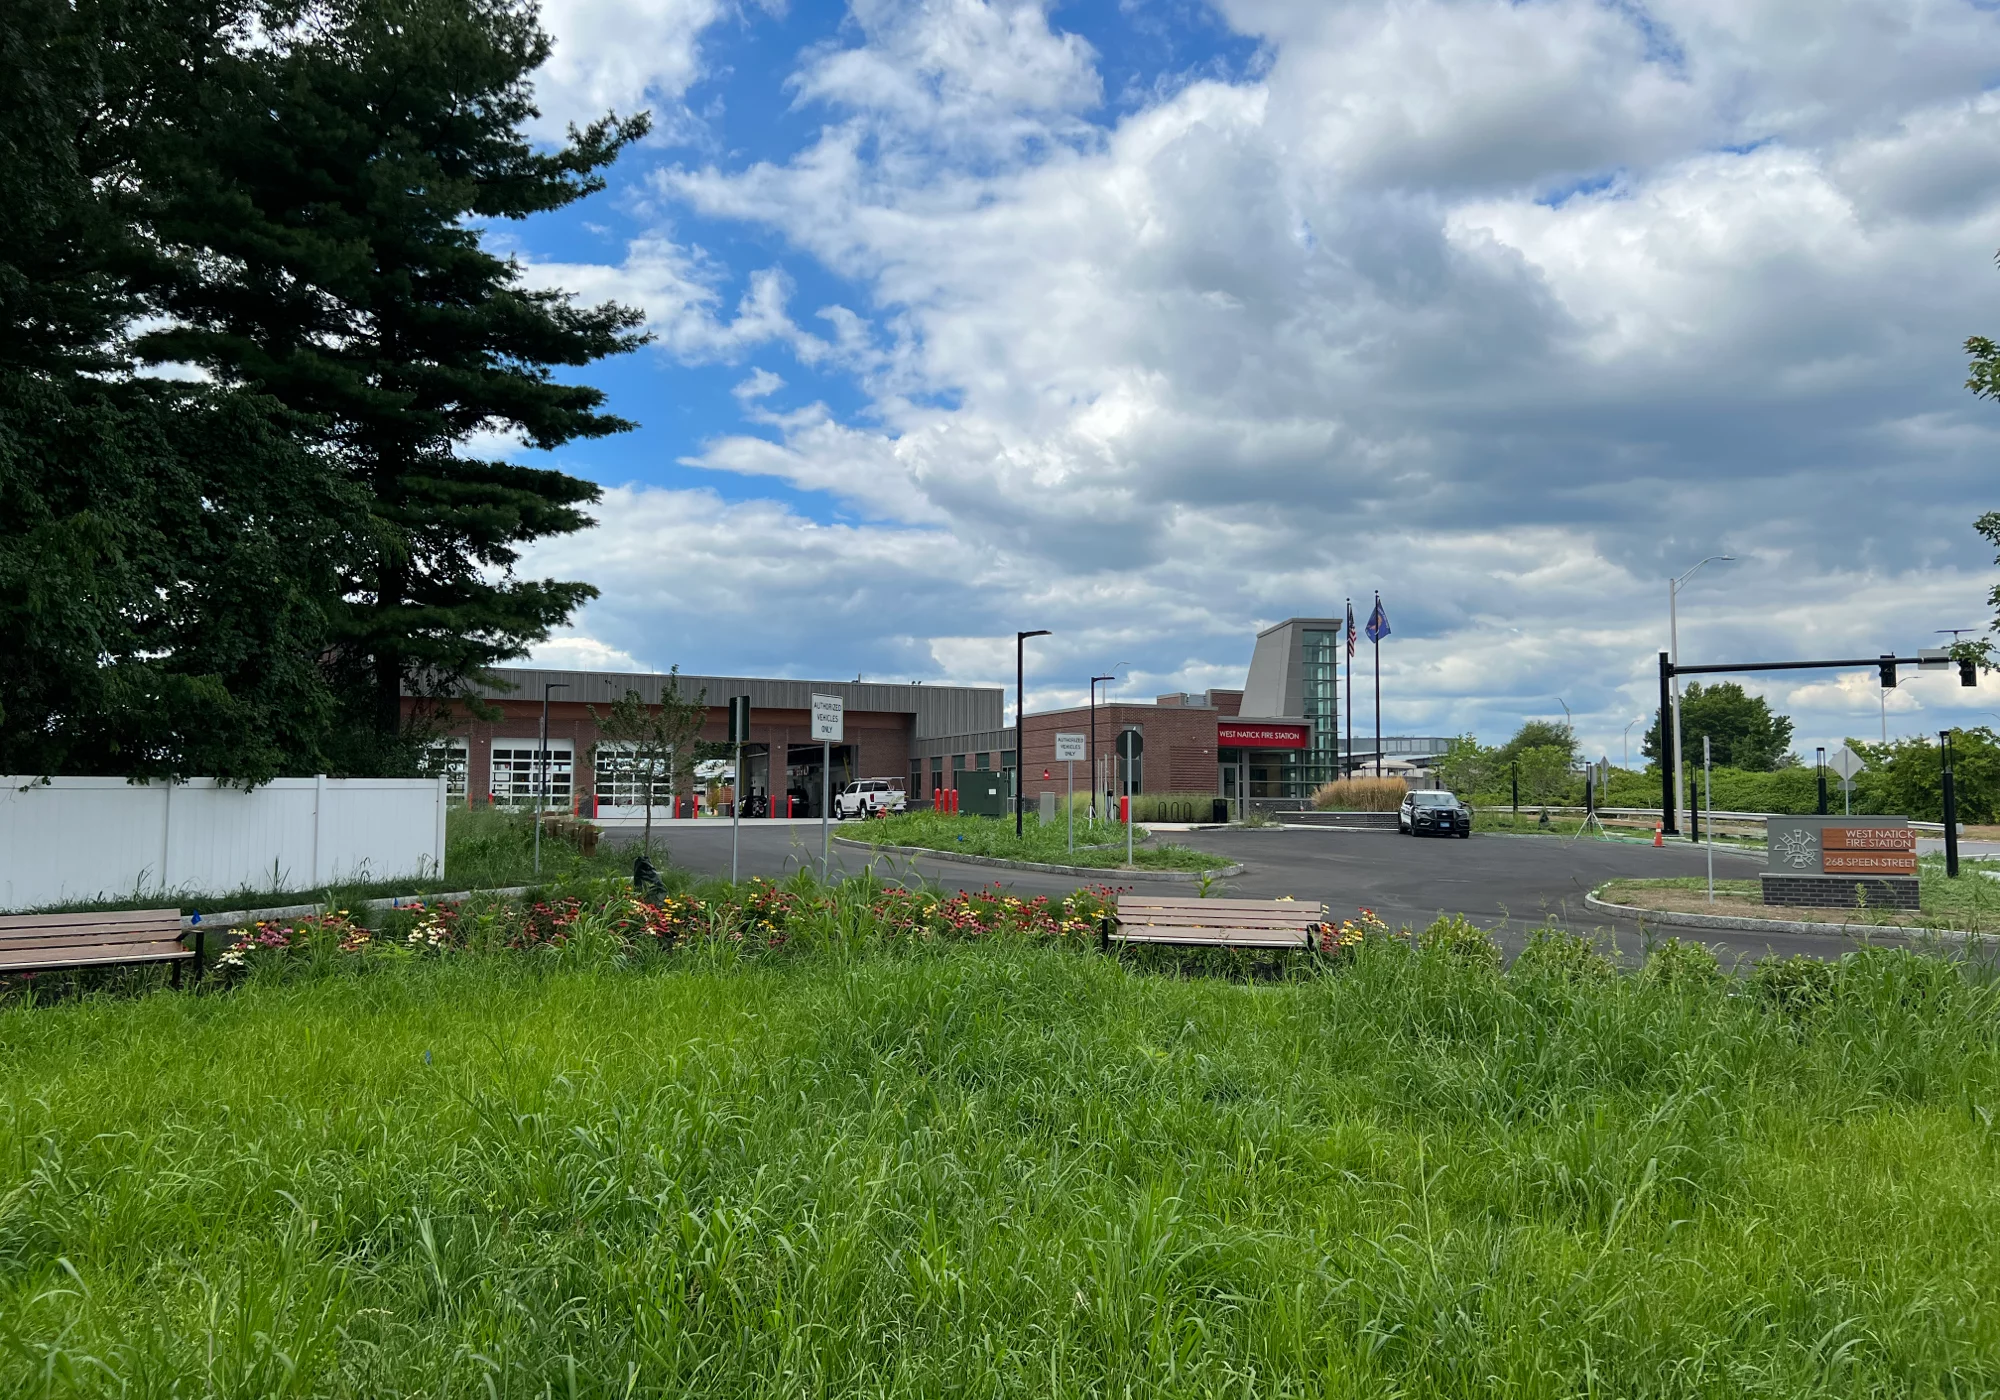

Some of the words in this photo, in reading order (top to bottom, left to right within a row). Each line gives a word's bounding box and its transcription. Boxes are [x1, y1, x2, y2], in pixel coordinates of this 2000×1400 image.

[814, 702, 841, 711] AUTHORIZED
[817, 713, 838, 722] VEHICLES
[821, 725, 832, 733] ONLY
[1219, 730, 1236, 738] WEST
[1237, 731, 1260, 739] NATICK
[1274, 732, 1300, 740] STATION
[1845, 829, 1873, 838] WEST
[1875, 829, 1914, 839] NATICK
[1845, 838, 1866, 847] FIRE
[1869, 839, 1911, 848] STATION
[1825, 857, 1844, 866] 268
[1846, 858, 1879, 867] SPEEN
[1881, 858, 1916, 868] STREET
